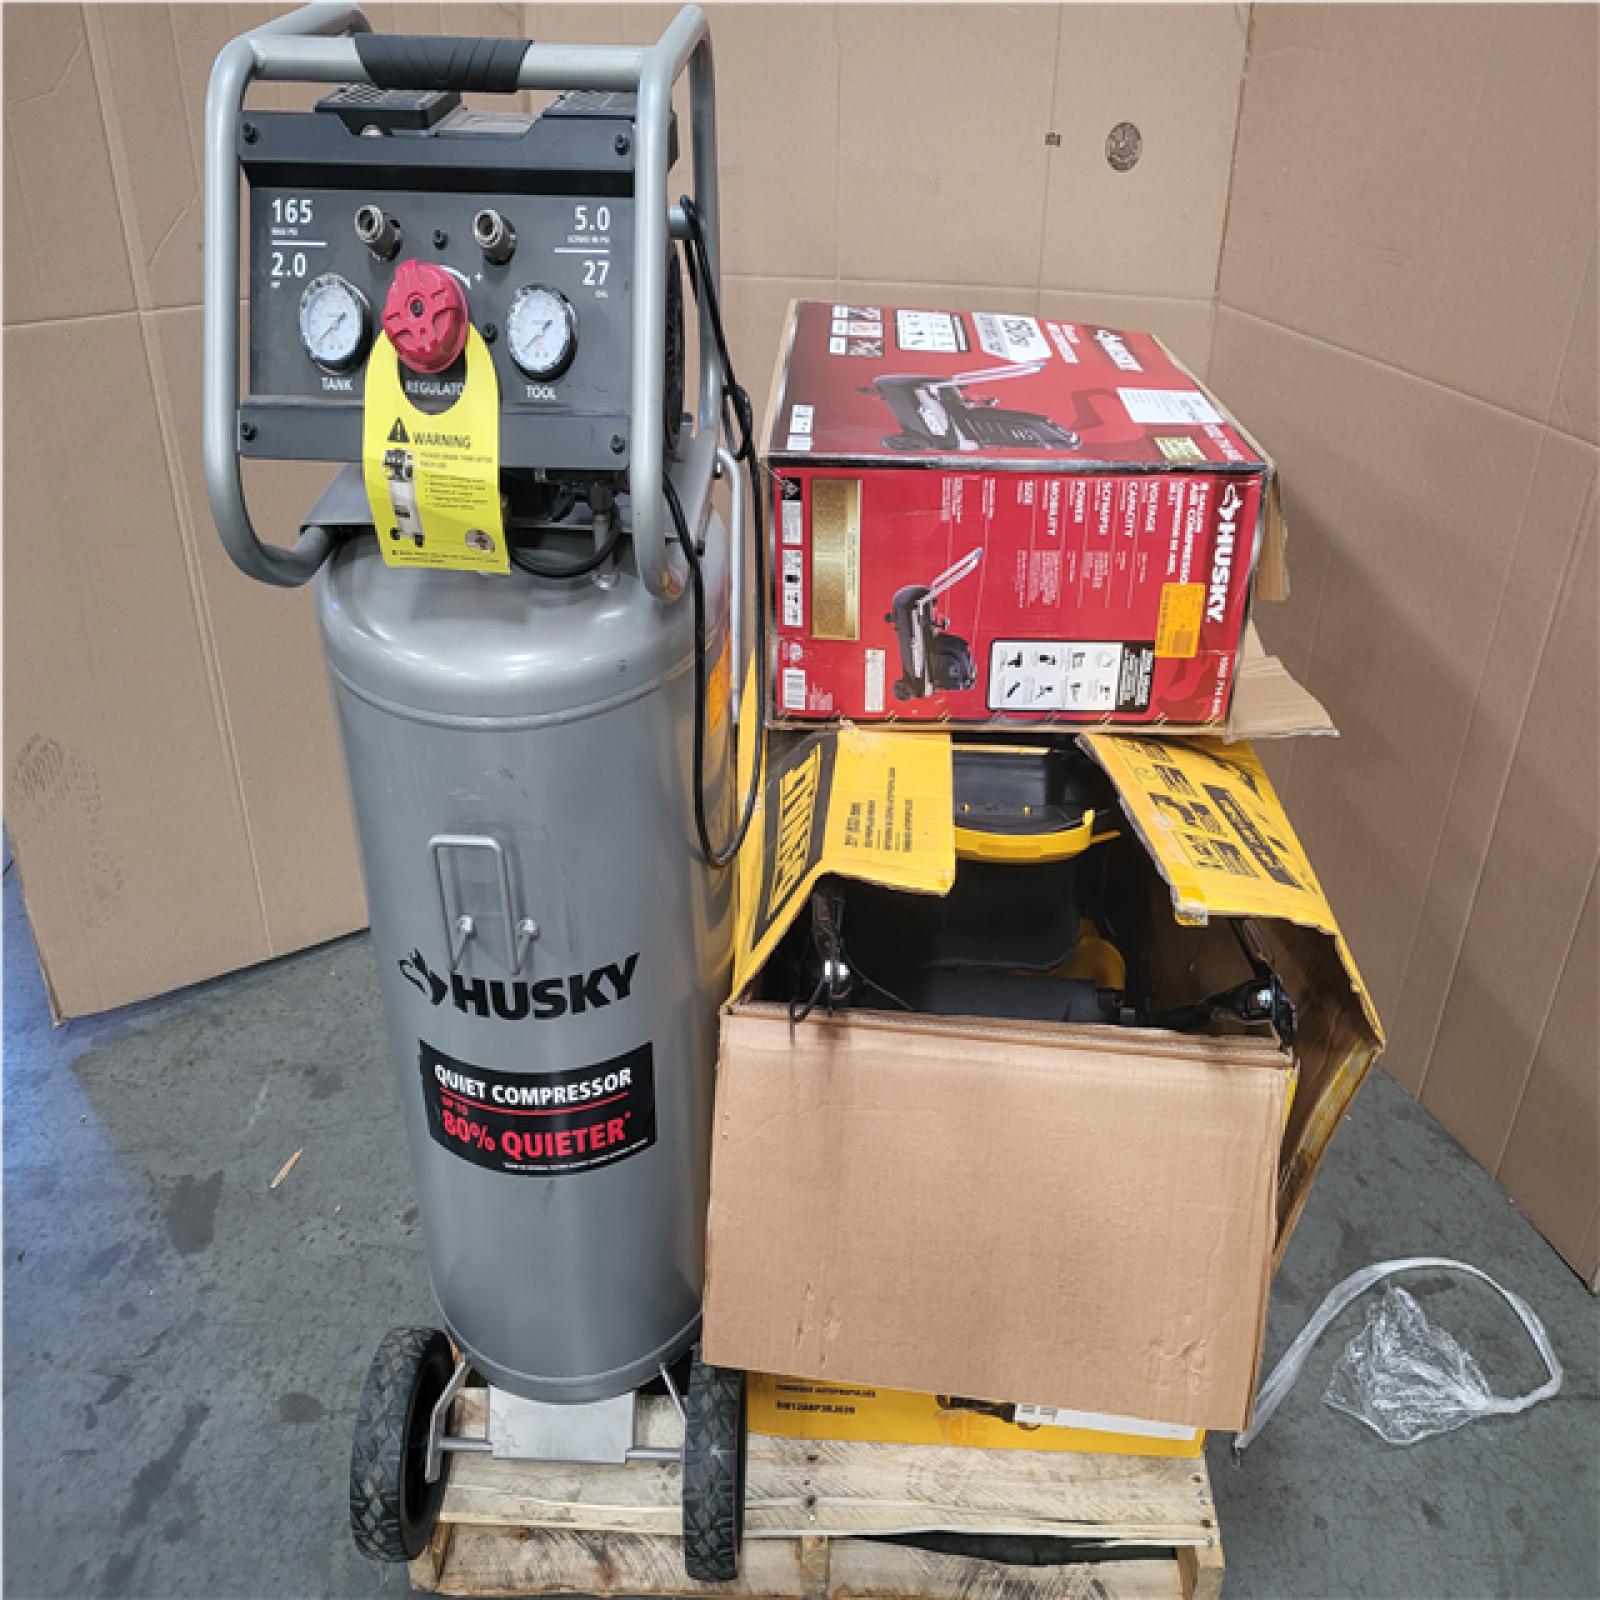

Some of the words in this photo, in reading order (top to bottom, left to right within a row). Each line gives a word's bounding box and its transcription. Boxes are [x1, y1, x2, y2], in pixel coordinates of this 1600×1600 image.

[272, 198, 313, 223] 165
[574, 205, 611, 231] 5.0
[271, 252, 307, 277] 2.0
[582, 260, 610, 286] 27
[320, 377, 353, 392] TANK
[406, 379, 464, 396] REGULATO
[525, 385, 556, 401] TOOL
[412, 432, 471, 450] WARNING
[1074, 481, 1086, 523] POWER
[1124, 482, 1138, 537] CAPACITY
[1145, 482, 1160, 533] VOLTAGE
[1180, 508, 1197, 586] COMPRESSO
[1205, 521, 1236, 623] HUSKY
[768, 742, 821, 918] DEWALT
[452, 952, 640, 1021] HUSKY
[434, 1064, 486, 1099] QUIET
[492, 1067, 633, 1106] COMPRESSOR
[443, 1109, 496, 1152] 80%
